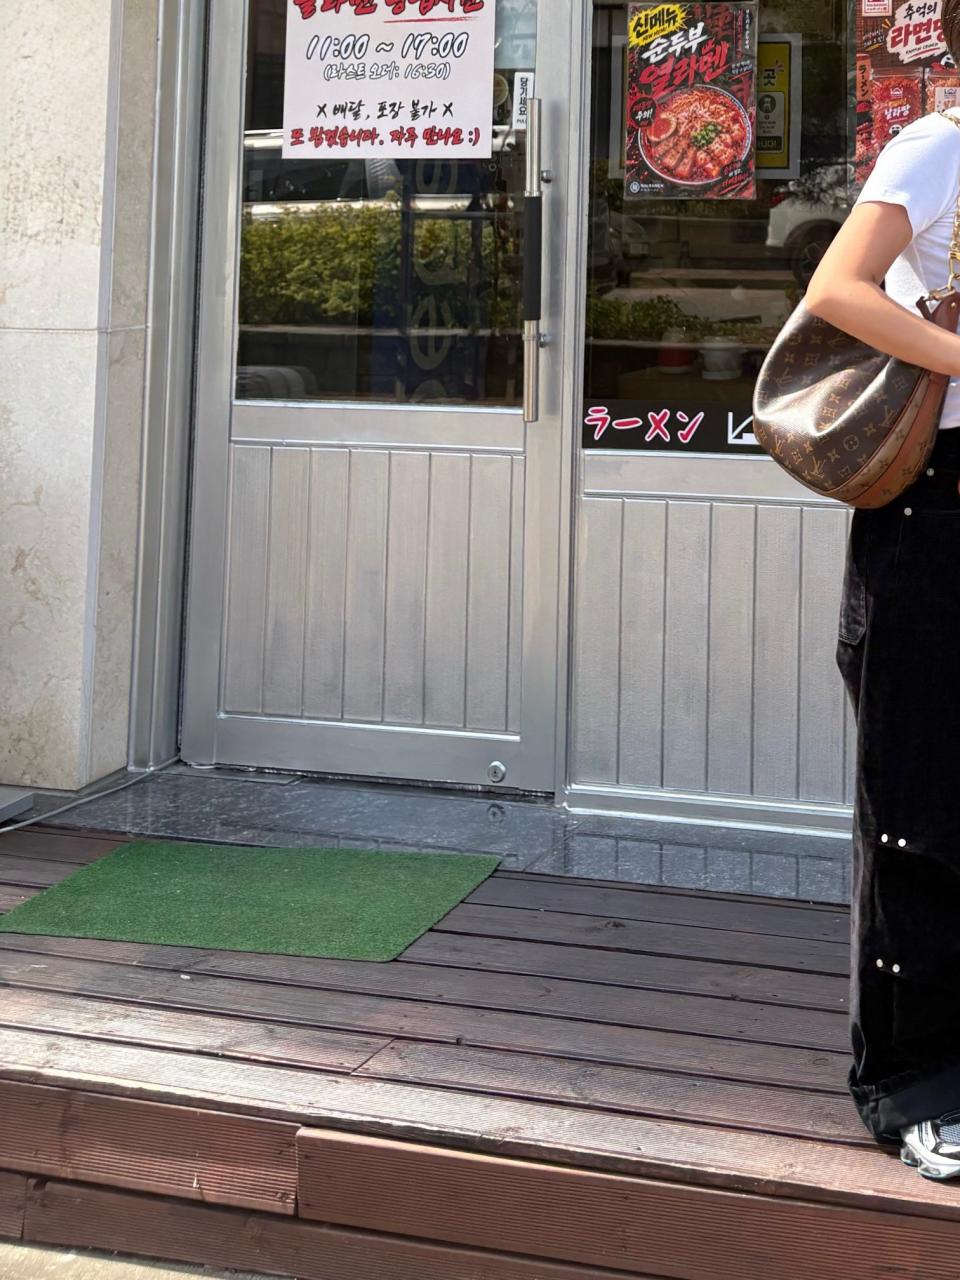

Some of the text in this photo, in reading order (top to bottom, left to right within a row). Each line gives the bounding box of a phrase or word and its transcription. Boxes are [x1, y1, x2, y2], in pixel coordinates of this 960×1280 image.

[633, 7, 678, 38] 신메뉴
[904, 1, 938, 20] 추억의
[306, 33, 370, 61] 11:00
[401, 32, 469, 60] 17:00
[641, 21, 712, 64] 순두부
[323, 61, 451, 81] (라스트 오더: 16:30)
[858, 64, 869, 98] ラーメン
[377, 101, 404, 120] 포장
[409, 99, 438, 121] 불가
[290, 128, 304, 147] 또
[389, 125, 419, 148] 자주
[422, 125, 464, 146] 만나요
[584, 406, 704, 443] ラーメン
